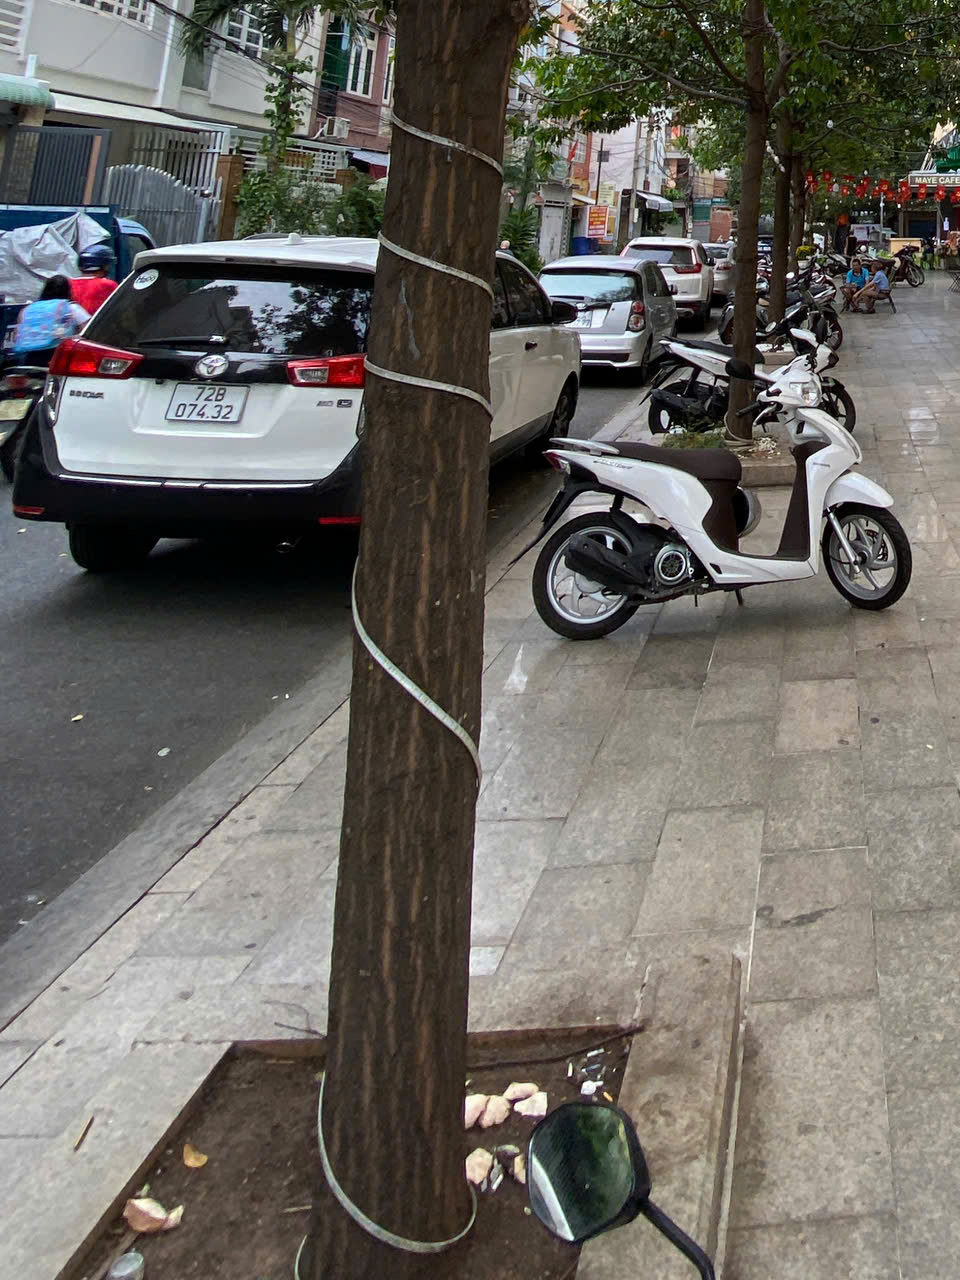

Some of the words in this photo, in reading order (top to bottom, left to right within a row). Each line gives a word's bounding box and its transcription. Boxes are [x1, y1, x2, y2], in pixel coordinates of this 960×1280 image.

[915, 176, 937, 184] MAYE
[939, 176, 960, 184] CAFE
[195, 386, 227, 402] 72B
[174, 402, 234, 420] 074.32
